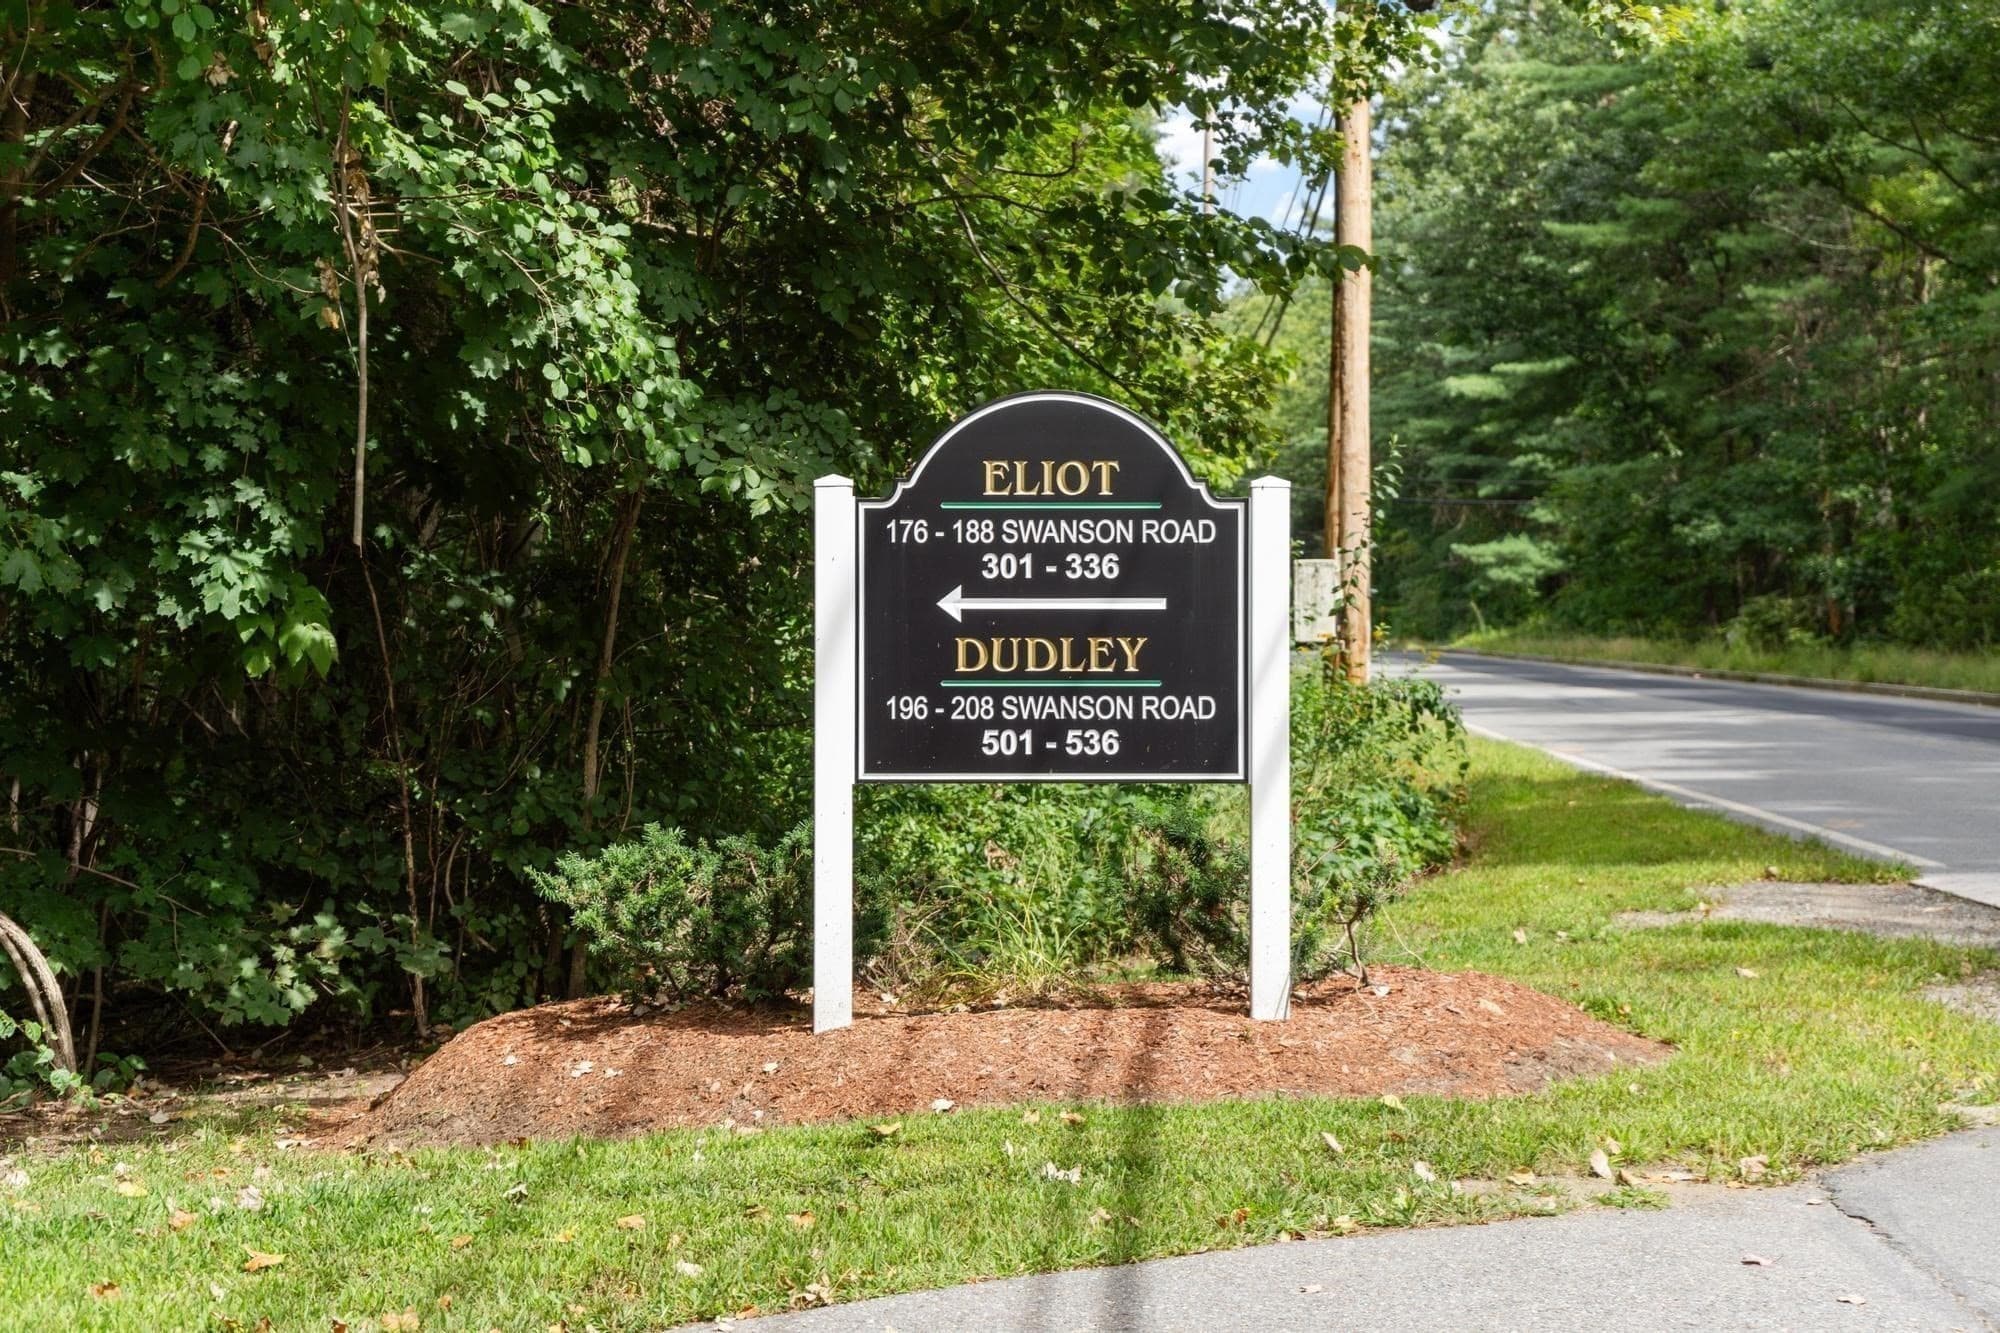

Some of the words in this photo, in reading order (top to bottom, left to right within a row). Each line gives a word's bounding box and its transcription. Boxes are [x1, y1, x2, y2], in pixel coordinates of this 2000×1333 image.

[982, 459, 1121, 497] ELIOT
[886, 518, 929, 544] 176
[952, 518, 995, 544] 188
[1001, 518, 1134, 545] SWANSON
[1141, 518, 1217, 544] ROAD
[981, 552, 1033, 580] 301
[1064, 552, 1120, 580] 336
[954, 636, 1149, 673] DUDLEY
[886, 695, 929, 721] 196
[950, 695, 995, 721] 208
[1001, 694, 1134, 721] SWANSON
[1141, 695, 1217, 721] ROAD
[981, 728, 1033, 756] 501
[1064, 728, 1122, 756] 536
